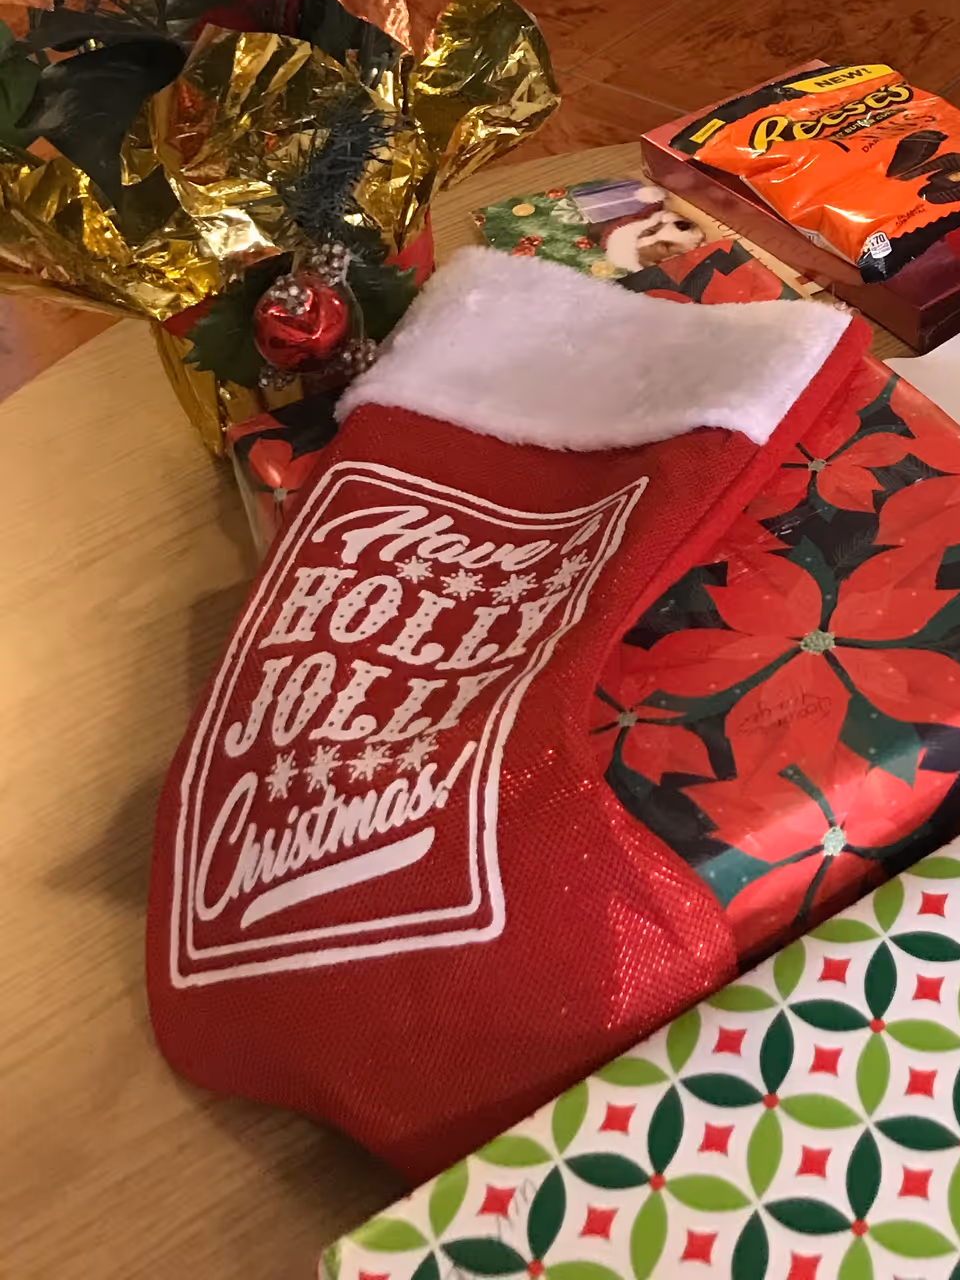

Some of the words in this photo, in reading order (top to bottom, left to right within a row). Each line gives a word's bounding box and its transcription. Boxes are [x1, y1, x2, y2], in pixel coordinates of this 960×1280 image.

[814, 67, 872, 89] NEW!
[312, 505, 558, 573] Have
[259, 566, 571, 672] HOLLY
[224, 652, 514, 758] JOLLY
[196, 740, 479, 921] Christmas!
